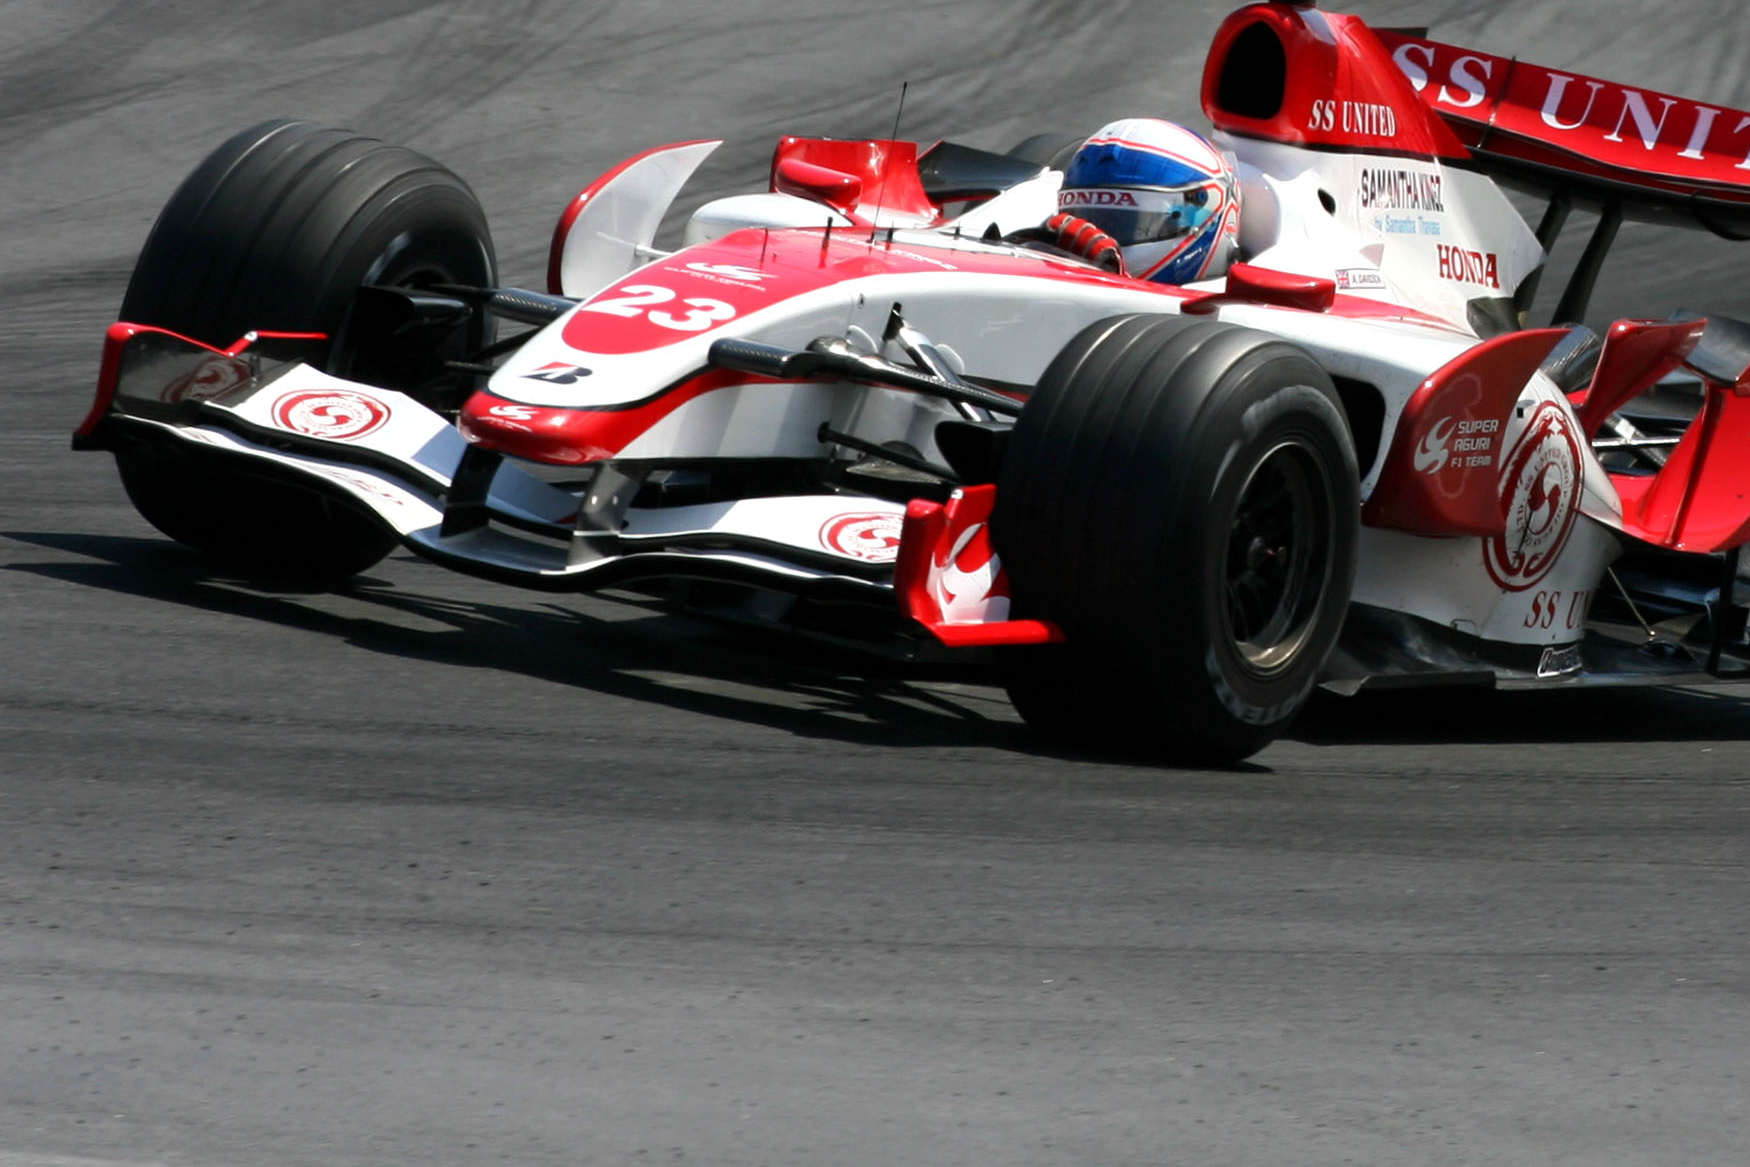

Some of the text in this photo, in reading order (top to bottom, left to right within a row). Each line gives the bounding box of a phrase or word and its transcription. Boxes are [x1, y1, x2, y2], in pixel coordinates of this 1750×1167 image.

[1308, 99, 1396, 137] SS UNITED
[1361, 168, 1420, 210] SAMANTHA
[1437, 244, 1500, 289] HONDA
[579, 284, 736, 331] 23
[1454, 438, 1491, 451] AGURI
[1458, 419, 1499, 434] SUPER
[1466, 455, 1491, 467] TEAM
[1523, 591, 1560, 630] SS
